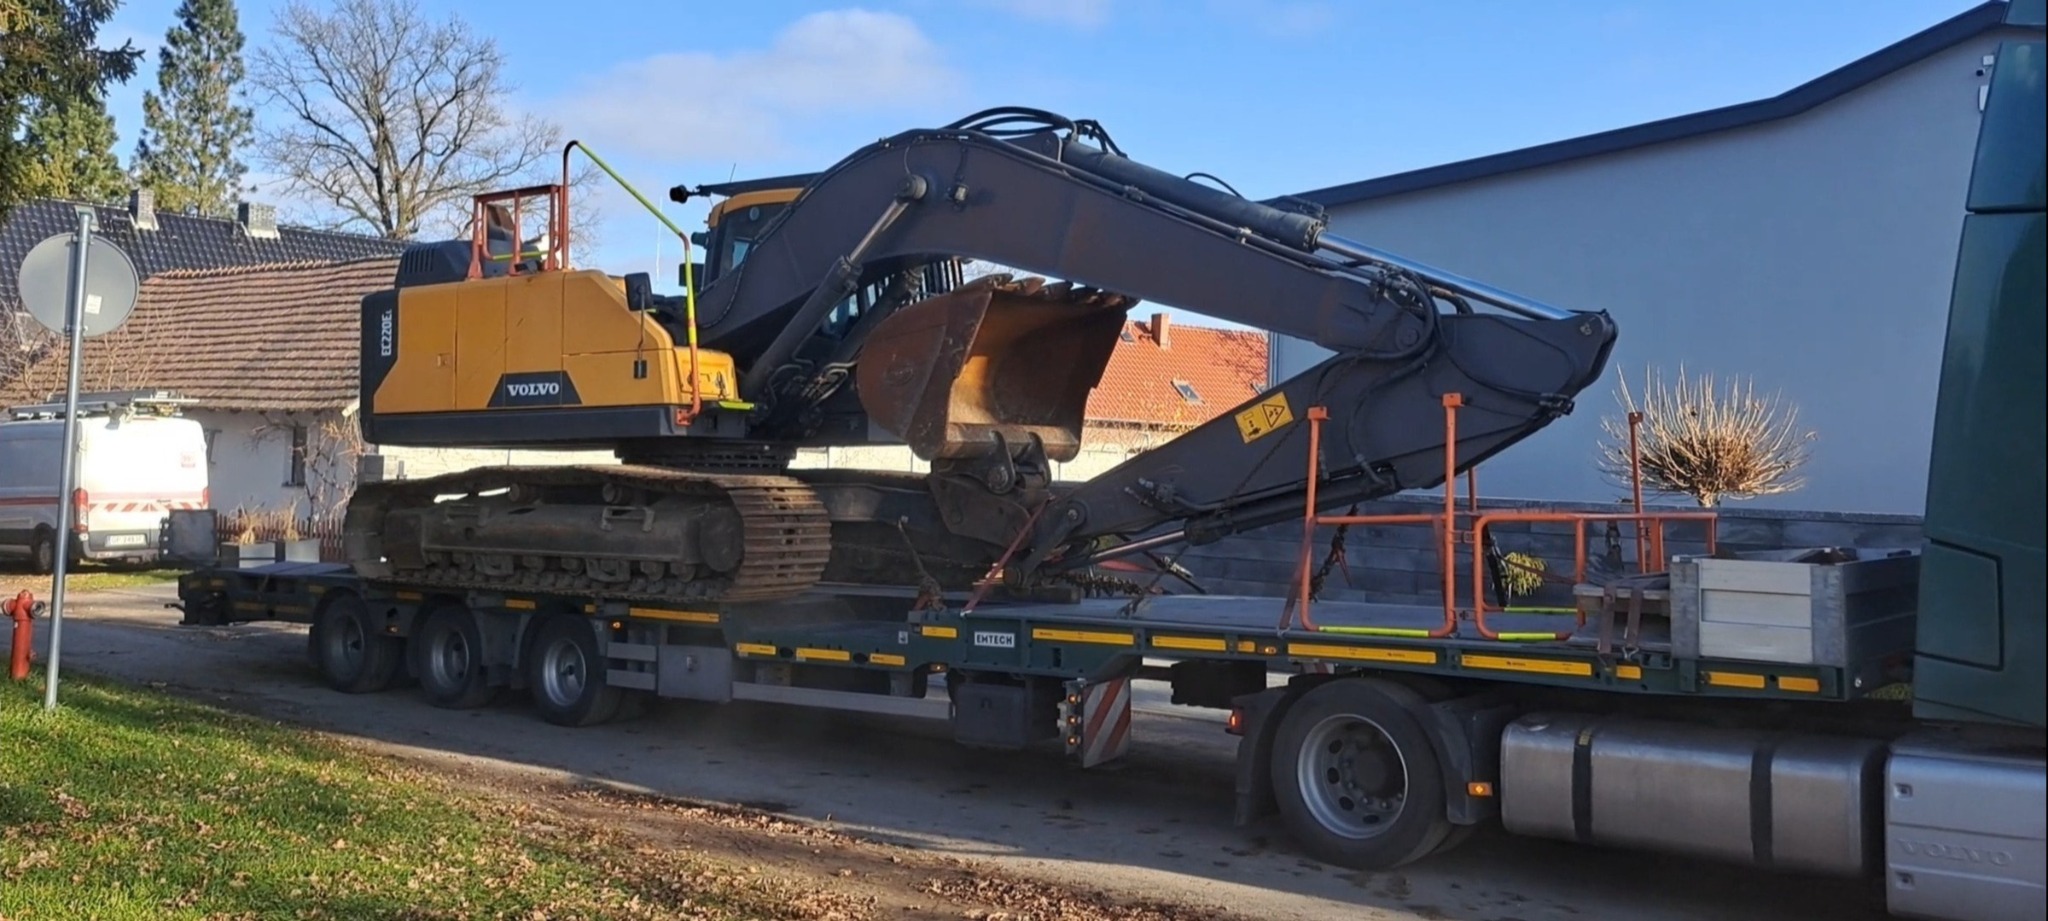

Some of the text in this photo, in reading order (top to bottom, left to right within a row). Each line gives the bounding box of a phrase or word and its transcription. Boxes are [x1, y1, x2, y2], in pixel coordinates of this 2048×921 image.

[507, 383, 559, 396] VOLVO
[977, 634, 1013, 645] EMTECH
[1898, 839, 2013, 866] VOLVO
